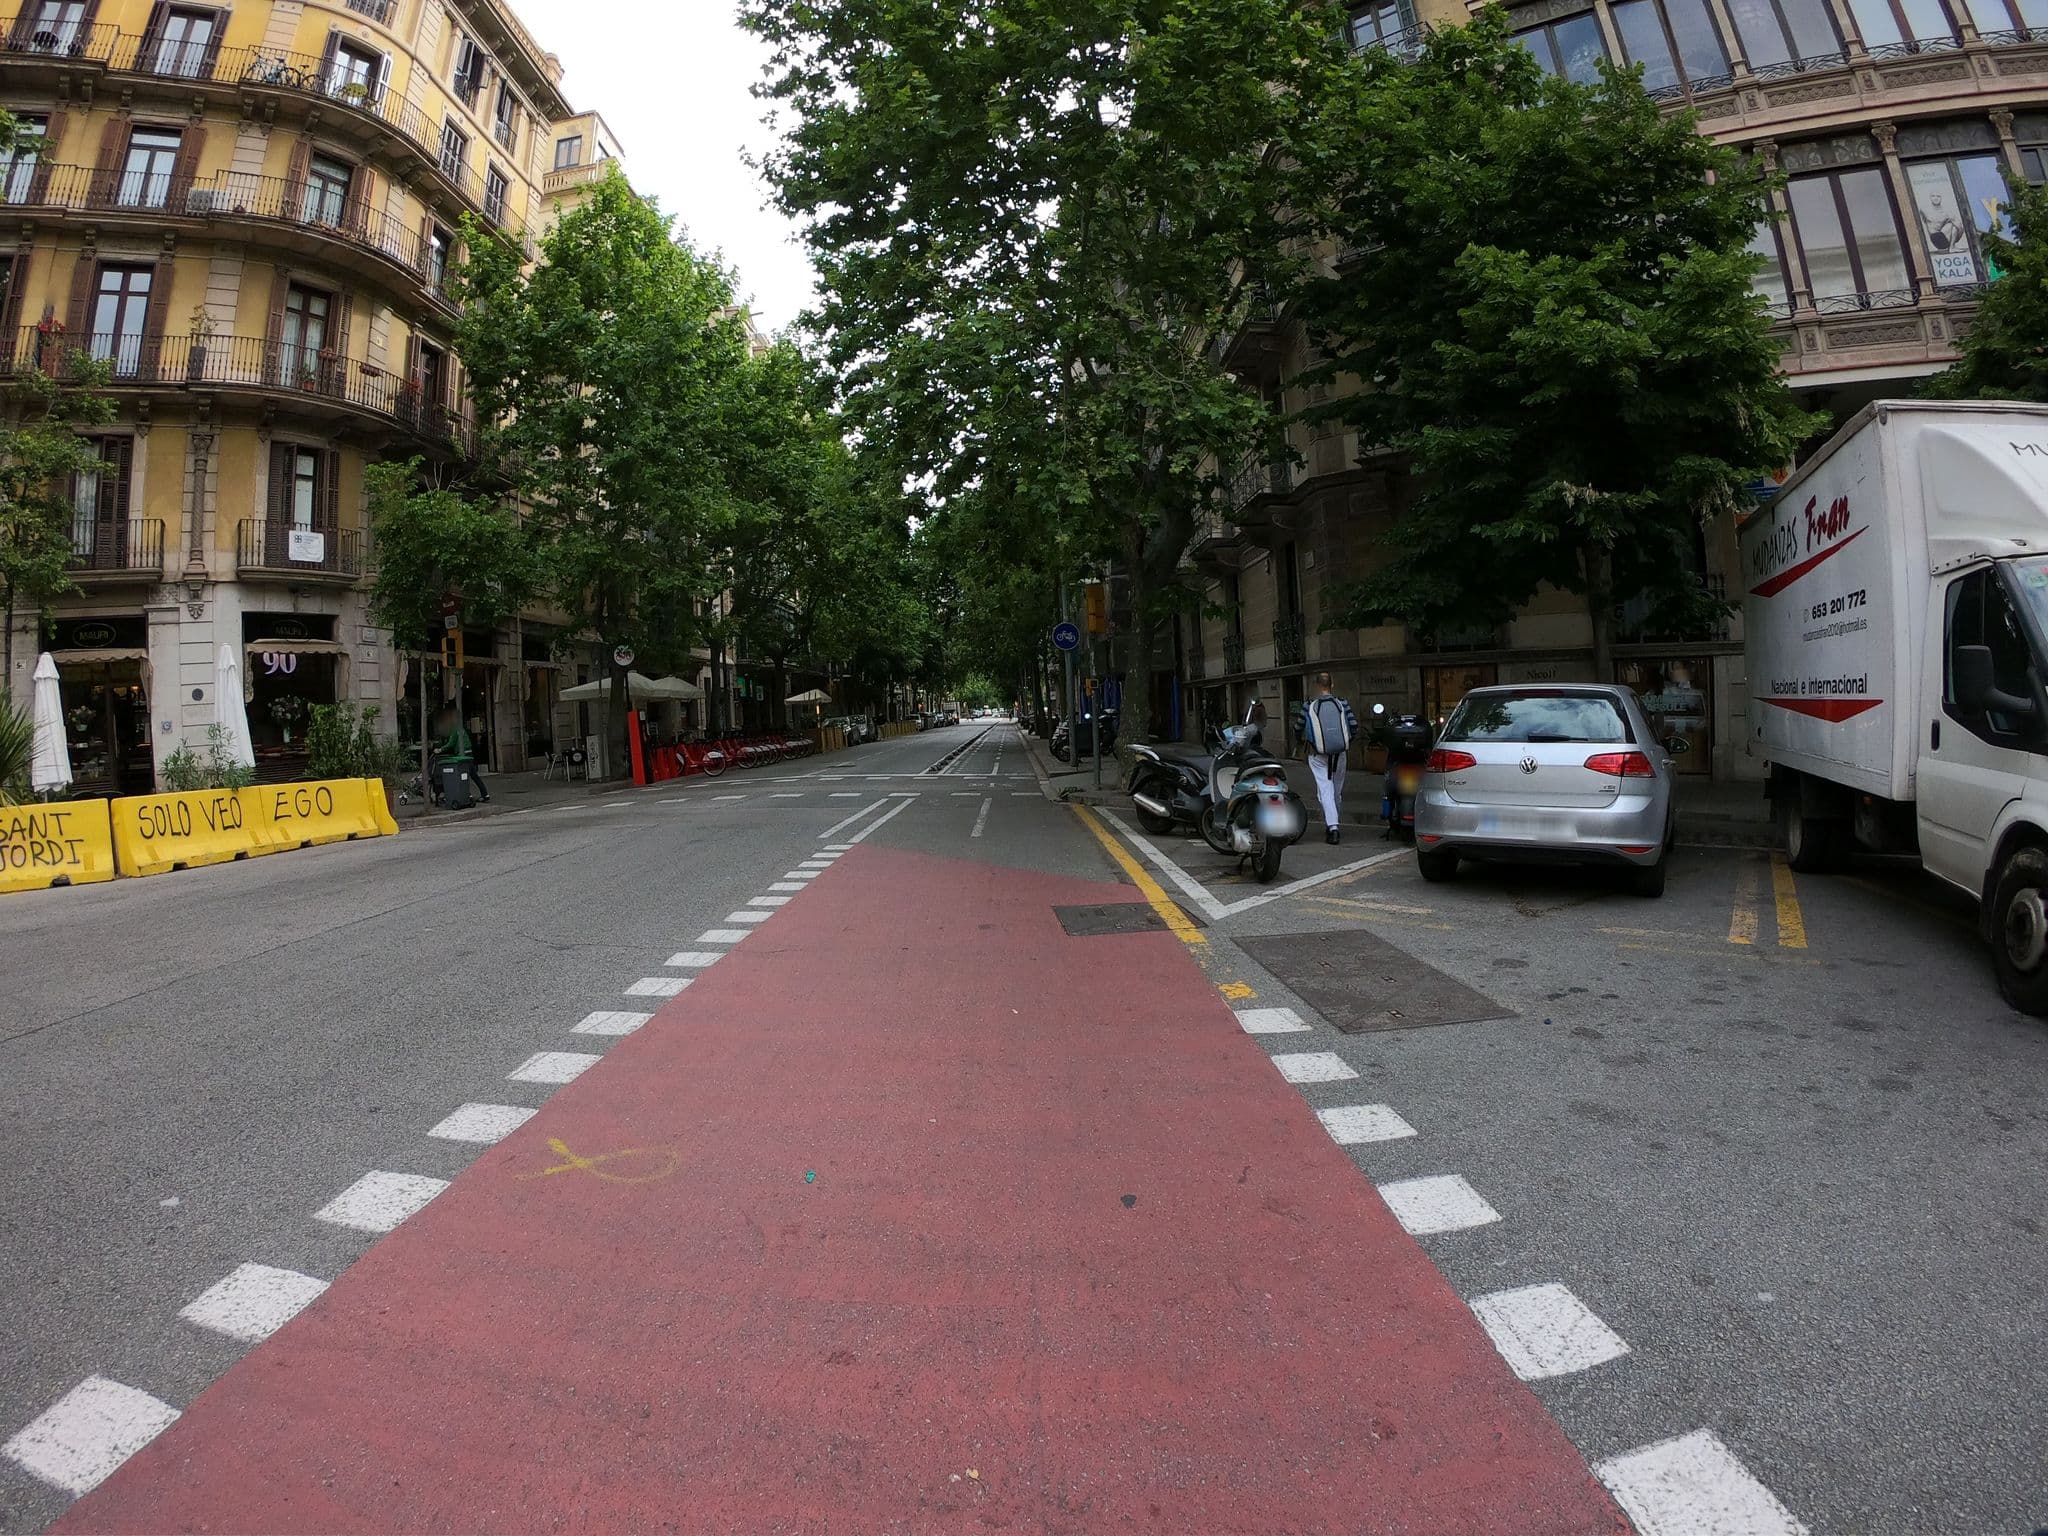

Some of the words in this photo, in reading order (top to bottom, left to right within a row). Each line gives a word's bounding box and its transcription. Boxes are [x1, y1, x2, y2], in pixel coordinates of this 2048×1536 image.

[1935, 256, 1971, 268] YOGA
[1938, 267, 1973, 279] KALA
[1752, 516, 1799, 577] MUDANZAS
[1805, 494, 1850, 553] Fran
[1812, 602, 1828, 620] 653
[1830, 597, 1845, 614] 201
[1847, 589, 1867, 610] 772
[262, 652, 297, 675] 90
[1771, 677, 1799, 694] Nacional
[1801, 681, 1806, 694] e
[1808, 672, 1868, 694] internacional
[138, 800, 191, 840] SOLO
[198, 795, 243, 832] VEO
[273, 786, 333, 821] EGO
[0, 839, 84, 872] JORDI
